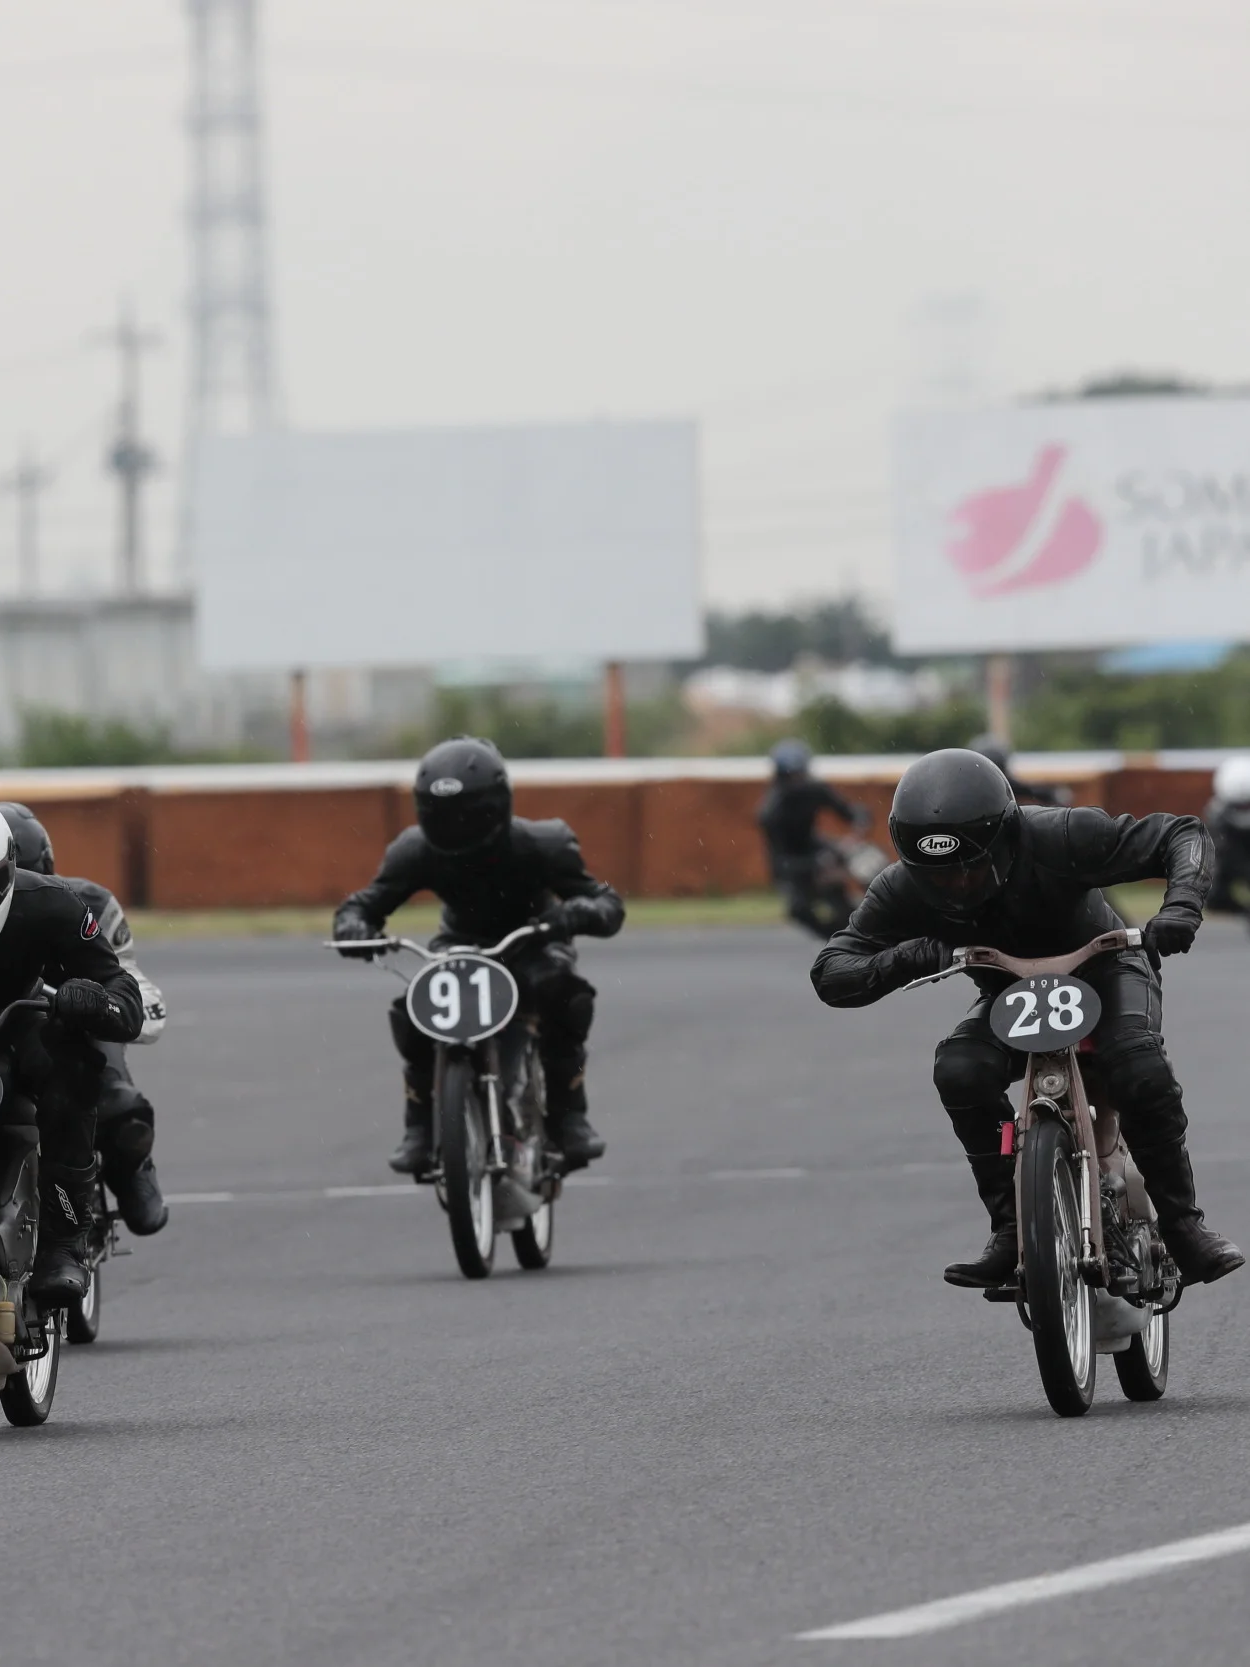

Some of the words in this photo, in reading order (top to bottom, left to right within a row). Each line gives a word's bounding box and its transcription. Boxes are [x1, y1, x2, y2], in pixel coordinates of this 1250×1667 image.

[921, 838, 953, 850] Arai
[429, 966, 492, 1030] 91
[1005, 985, 1084, 1038] 28
[54, 1183, 78, 1225] RST
